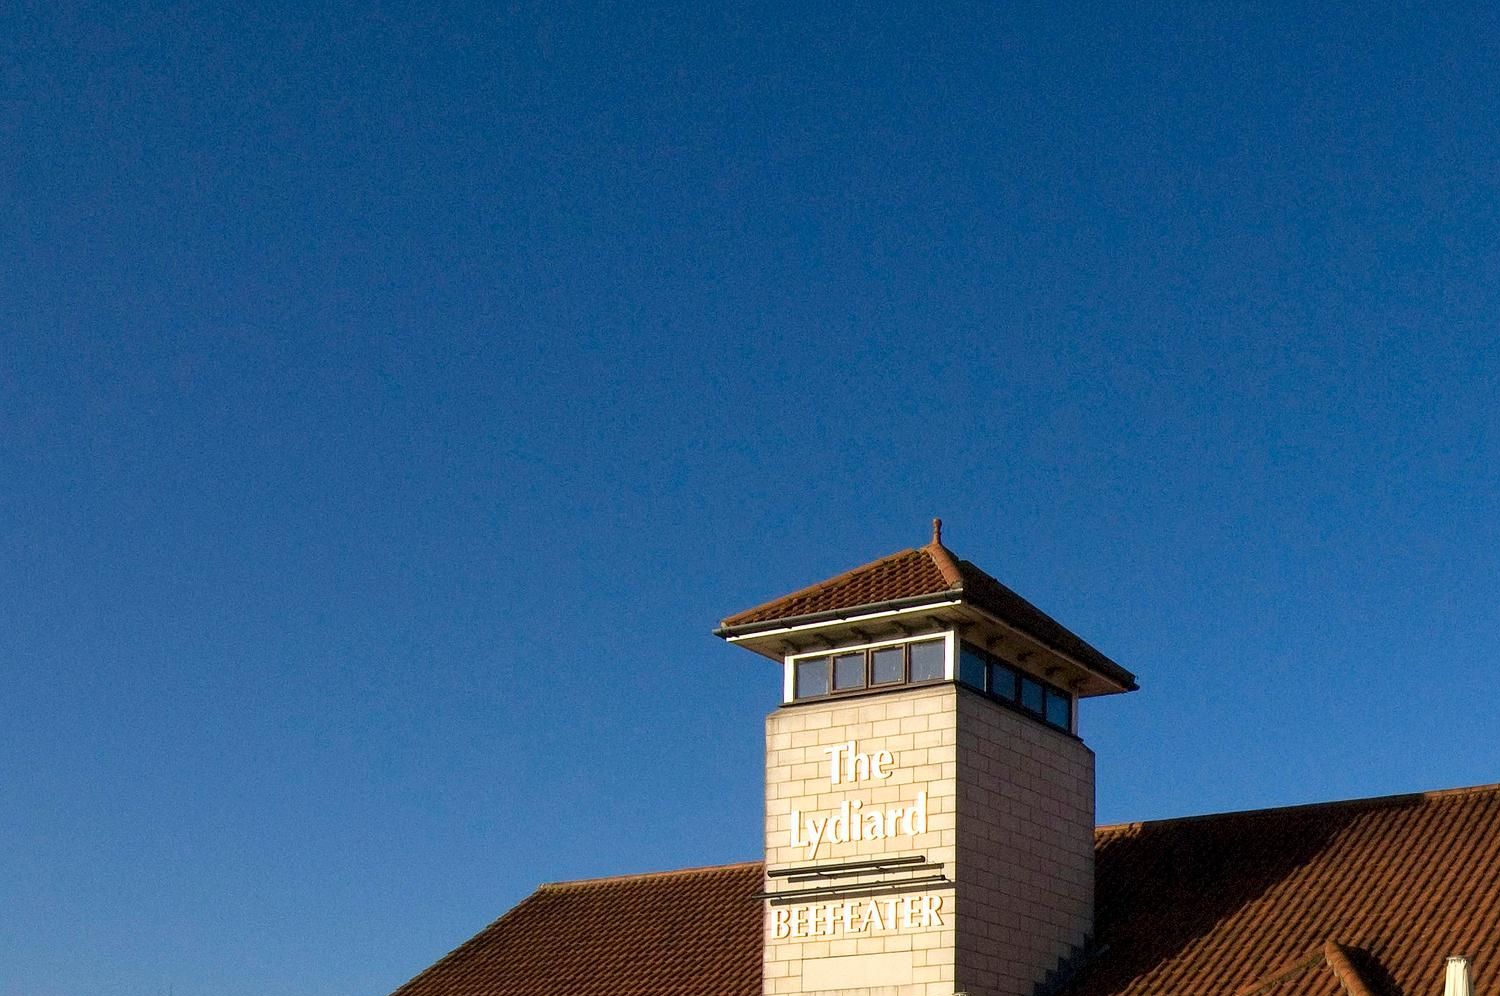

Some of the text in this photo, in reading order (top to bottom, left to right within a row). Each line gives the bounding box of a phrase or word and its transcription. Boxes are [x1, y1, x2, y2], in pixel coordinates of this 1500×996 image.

[825, 740, 894, 785] The
[790, 791, 928, 860] Lydiard
[770, 895, 944, 940] BEEFEATER
